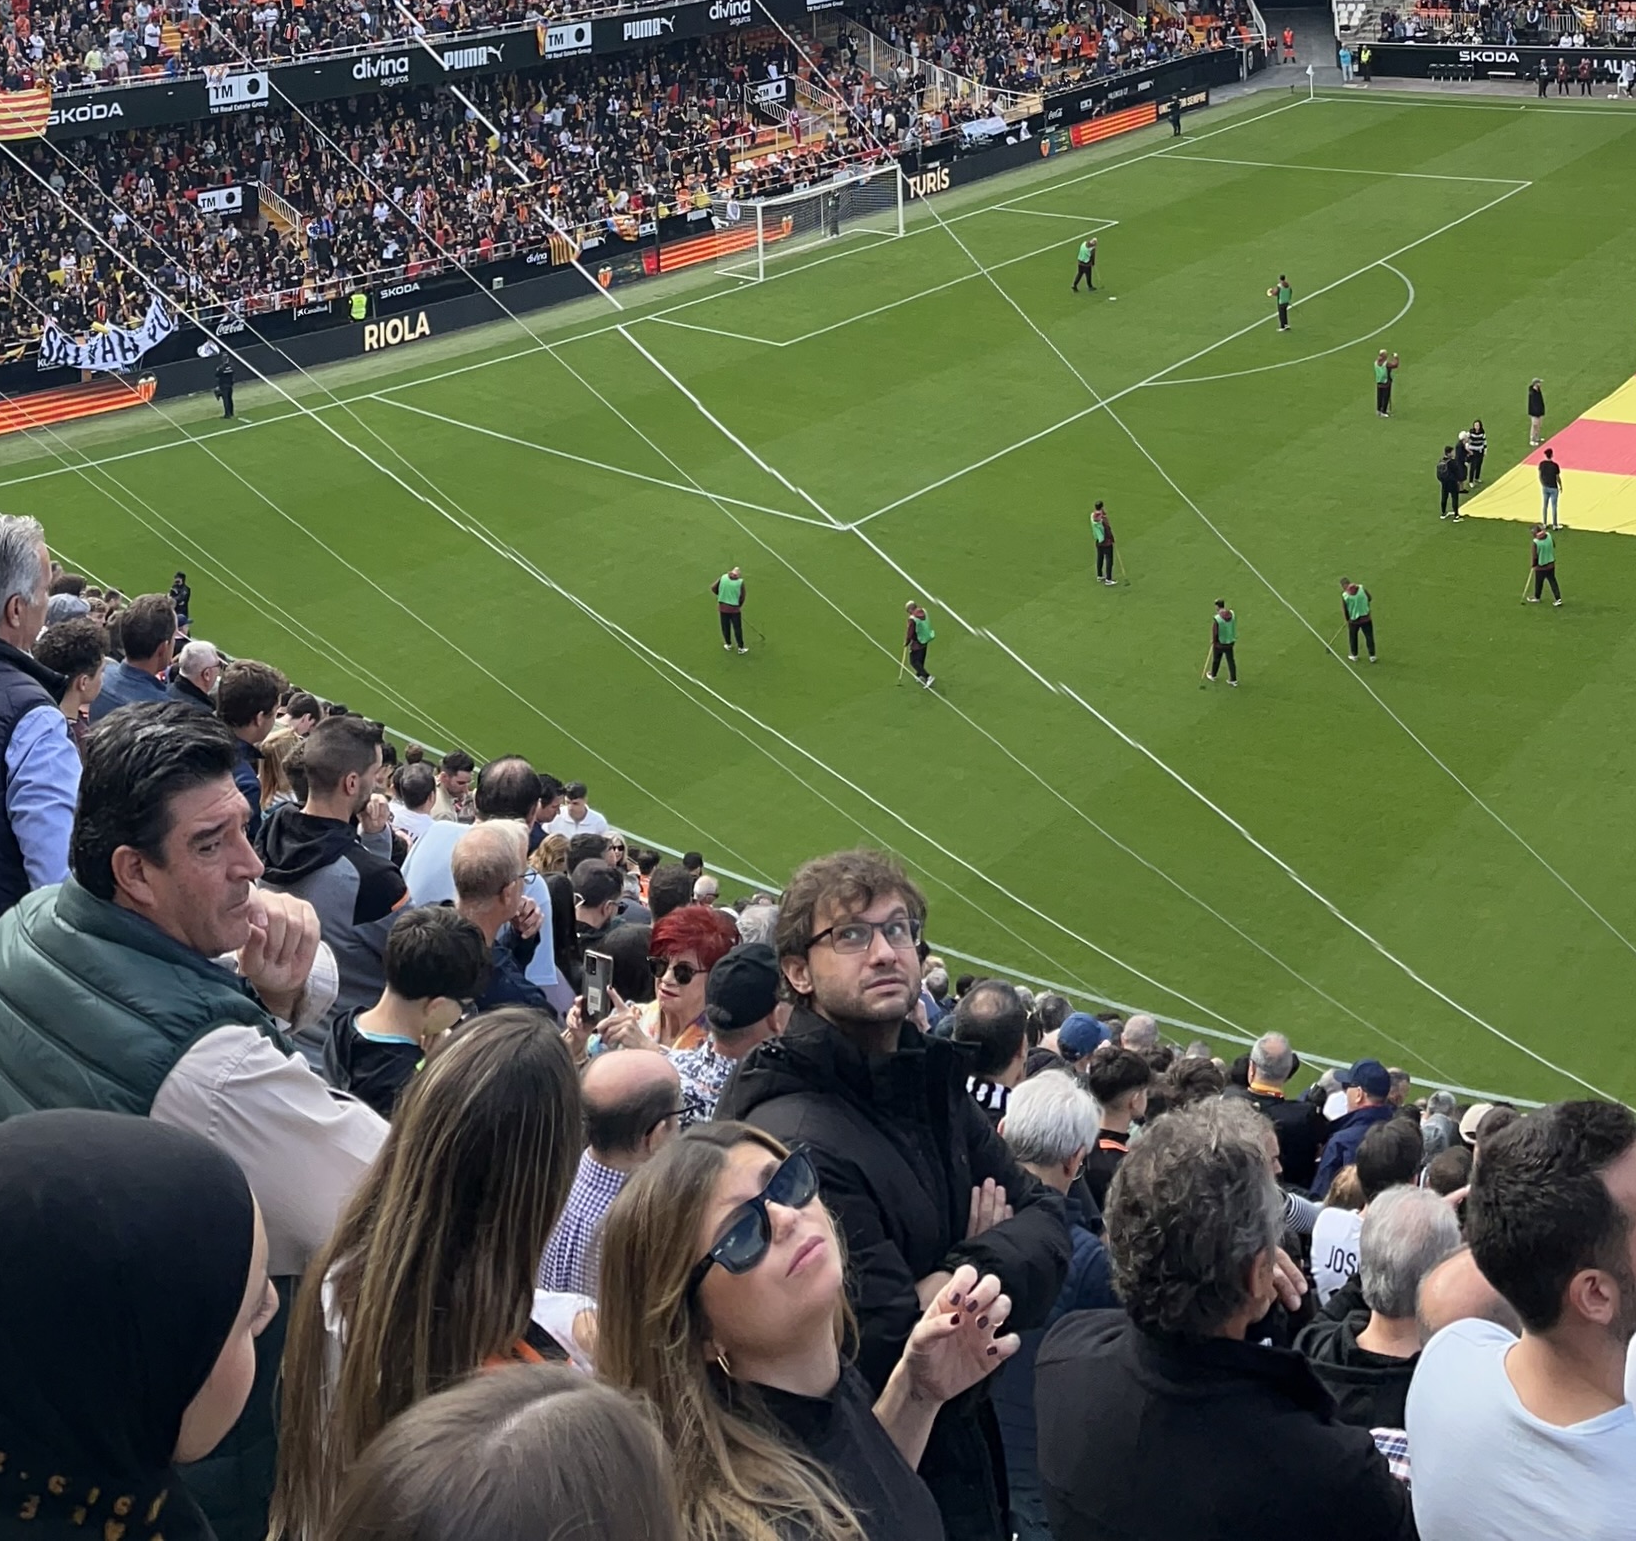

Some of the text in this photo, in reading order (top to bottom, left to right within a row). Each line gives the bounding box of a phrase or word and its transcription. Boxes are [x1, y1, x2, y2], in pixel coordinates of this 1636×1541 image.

[548, 32, 564, 48] TM
[623, 16, 662, 41] PUMA
[352, 55, 410, 80] divina
[444, 45, 489, 70] PUMA
[380, 75, 410, 88] seguros
[220, 103, 233, 113] Real
[251, 99, 269, 112] Group
[908, 166, 950, 199] TURÍS
[201, 196, 216, 209] TM
[364, 311, 431, 351] RIOLA
